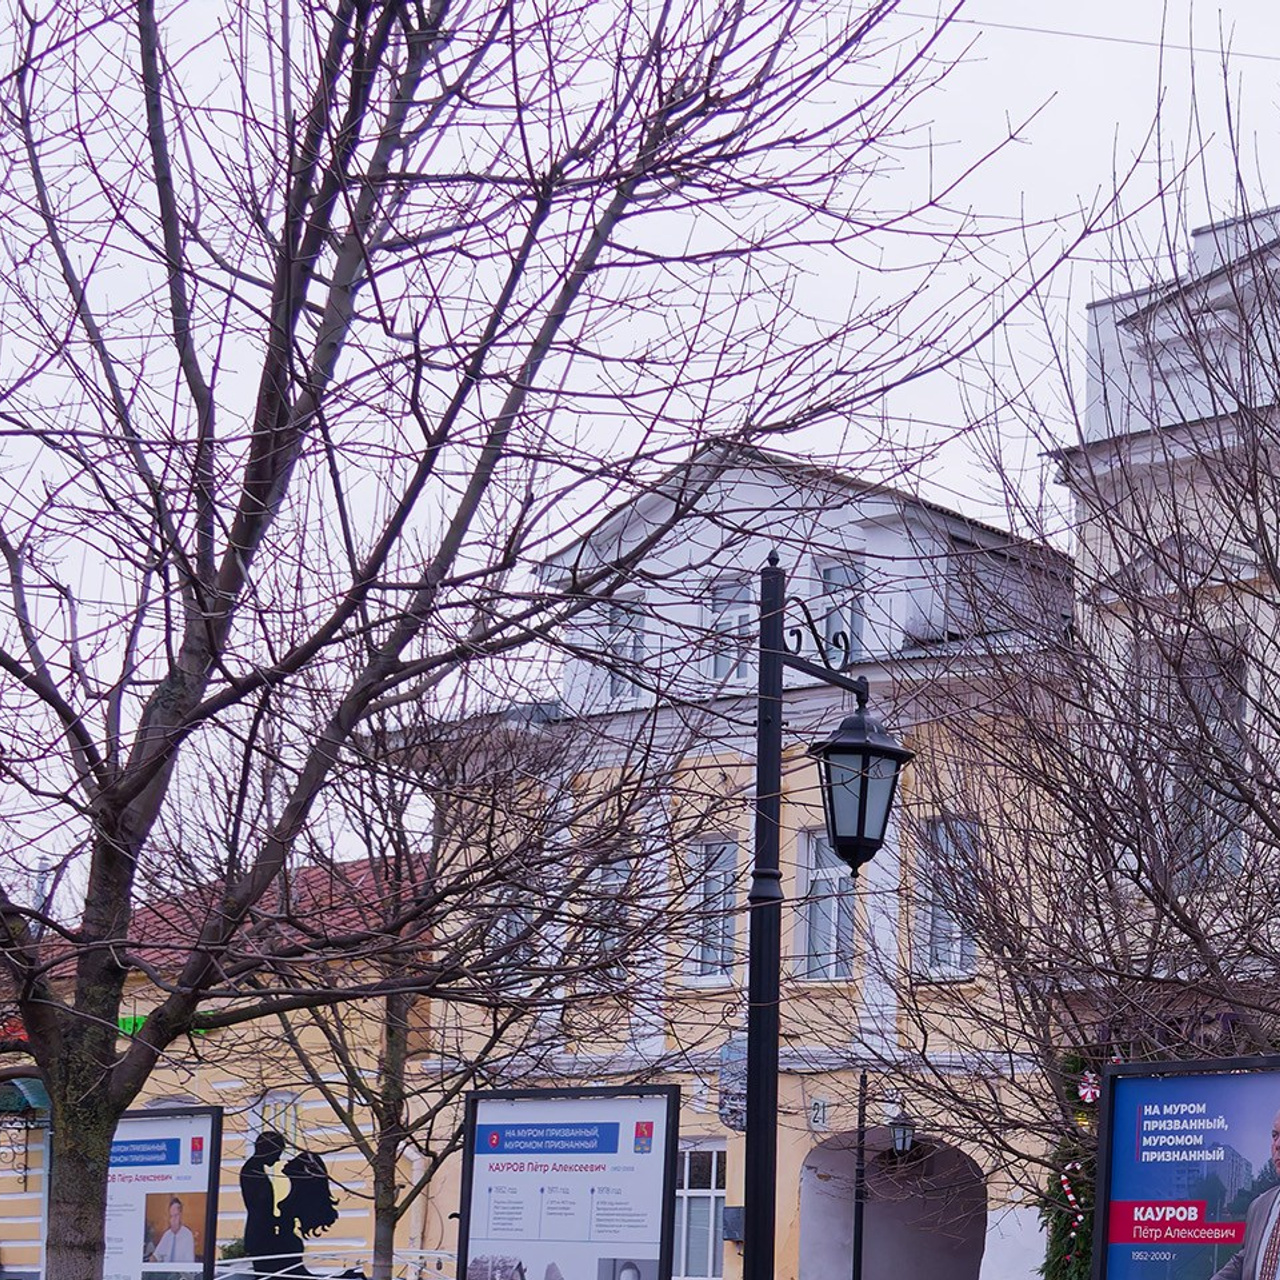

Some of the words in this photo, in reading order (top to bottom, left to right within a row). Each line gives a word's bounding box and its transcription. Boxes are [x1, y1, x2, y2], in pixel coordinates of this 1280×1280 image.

[812, 1102, 825, 1124] 21
[1143, 1104, 1161, 1116] НА
[1163, 1103, 1206, 1115] МУРОМ
[1143, 1115, 1228, 1131] ПРИЗВАННЫЙ,
[1142, 1135, 1203, 1146] МУРОМОМ
[1141, 1147, 1225, 1162] ПРИЗНАННЫЙ
[488, 1162, 525, 1172] КАУРОВ
[527, 1162, 549, 1174] Пётр
[551, 1162, 606, 1172] Алексеевич
[1133, 1206, 1198, 1221] КАУРОВ
[1132, 1225, 1162, 1240] Пётр
[1163, 1226, 1236, 1239] Алексеевич
[1131, 1251, 1171, 1261] 1952-2000
